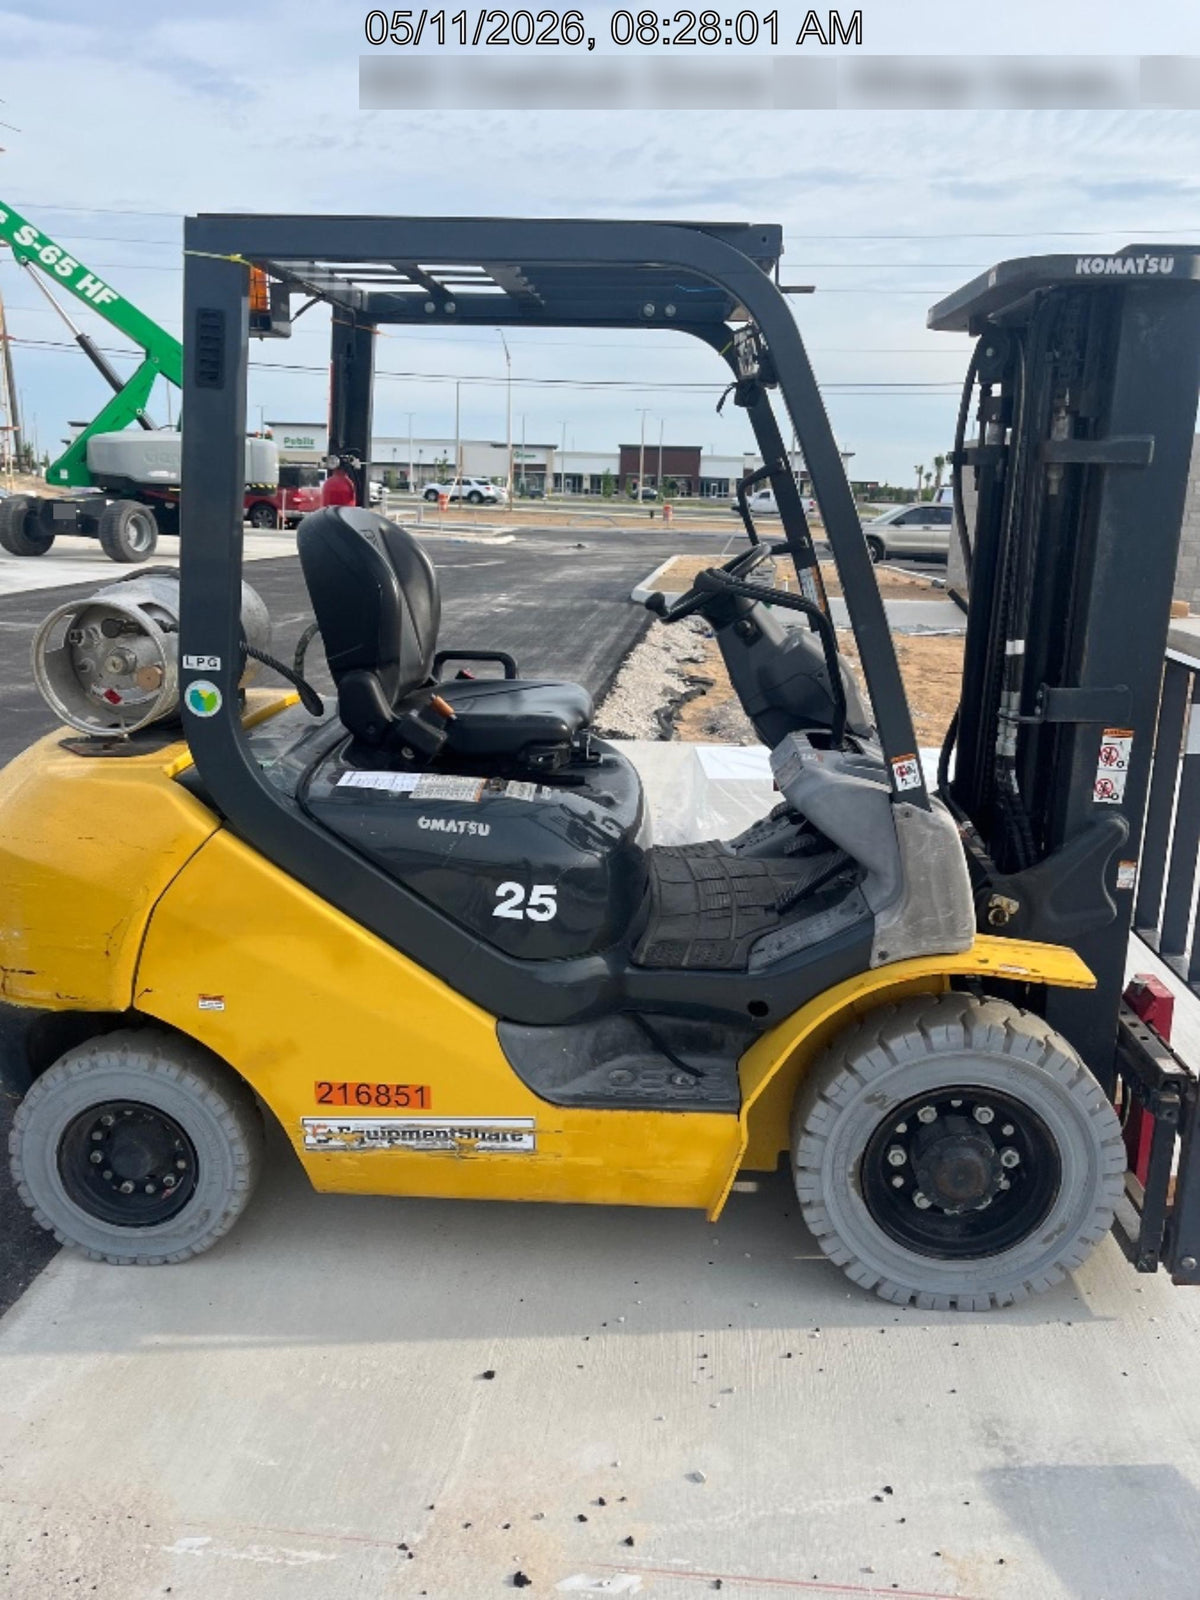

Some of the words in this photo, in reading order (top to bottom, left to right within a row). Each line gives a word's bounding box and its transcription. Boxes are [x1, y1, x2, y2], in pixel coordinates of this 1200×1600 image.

[13, 225, 79, 277] S-65
[75, 273, 119, 304] HF
[1075, 254, 1174, 274] KOMATSU
[492, 881, 557, 922] 25
[316, 1081, 426, 1108] 216851
